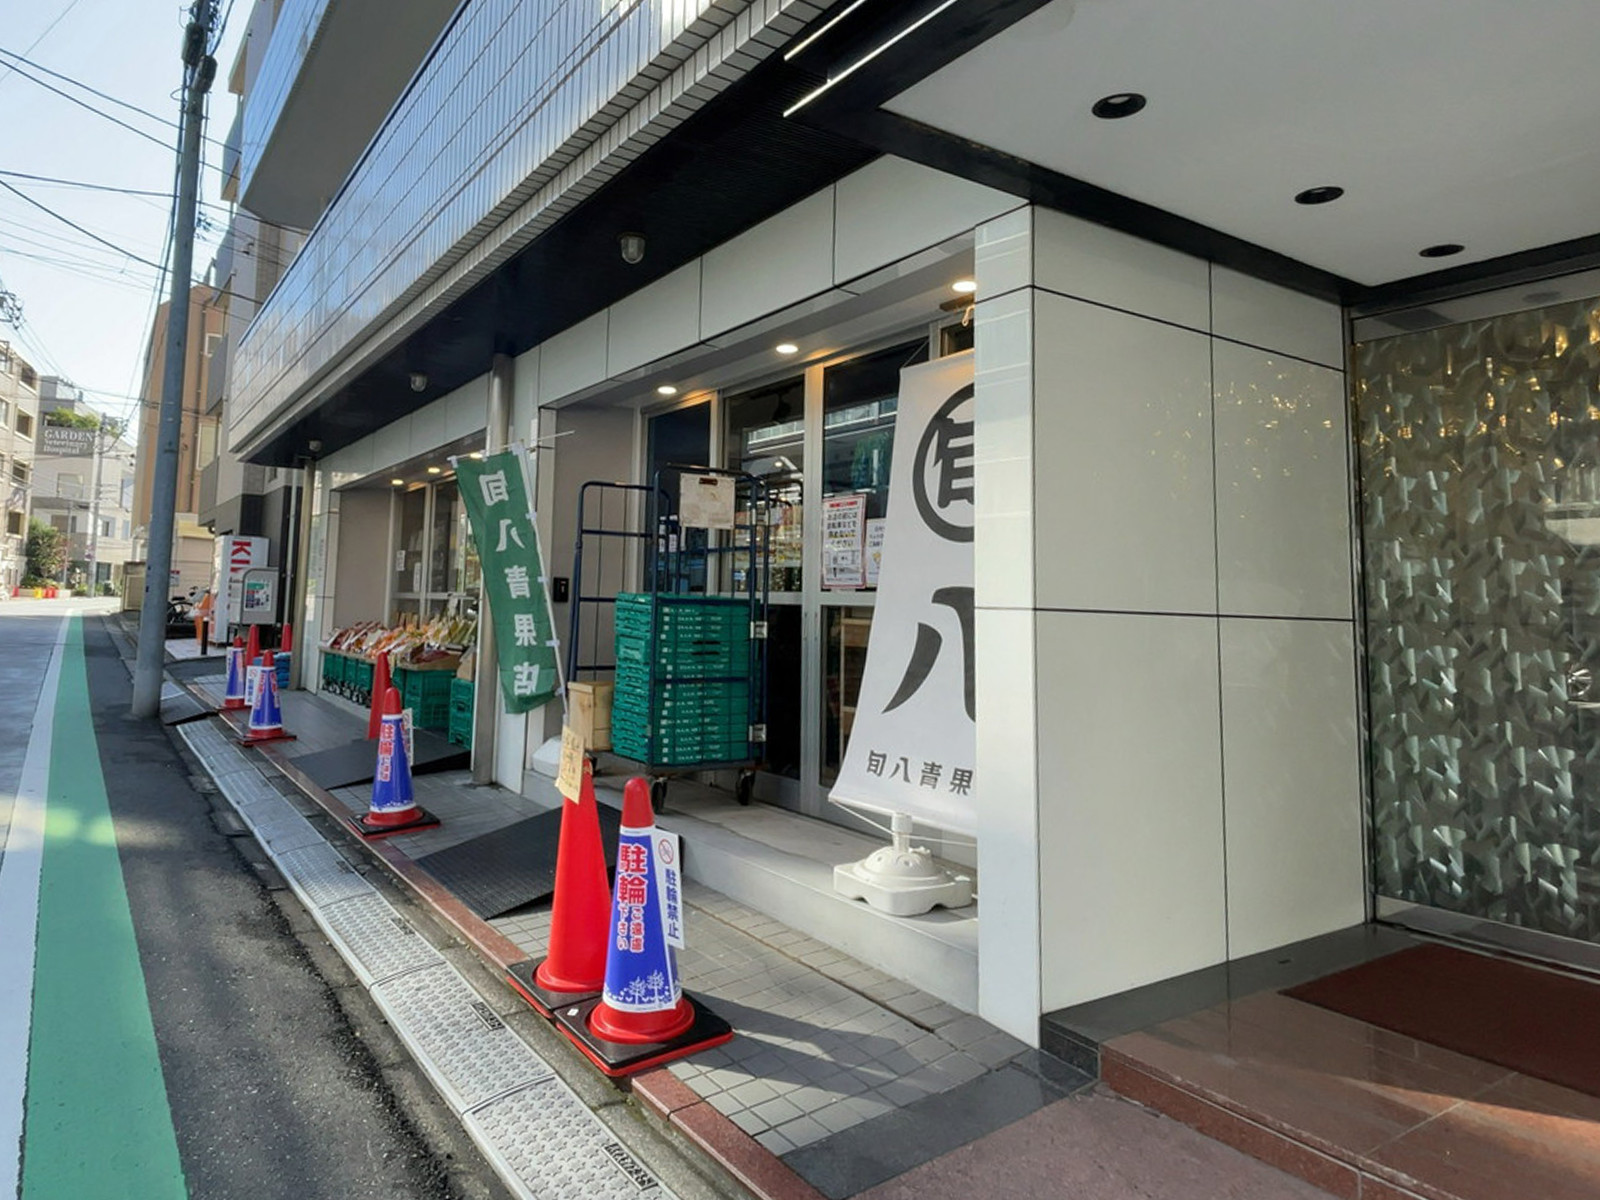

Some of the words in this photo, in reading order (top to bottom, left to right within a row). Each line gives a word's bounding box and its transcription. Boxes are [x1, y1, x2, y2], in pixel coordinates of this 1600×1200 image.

[44, 429, 93, 442] GARDEN
[866, 750, 974, 796] 旬八青果
[618, 844, 648, 905] 駐輪
[665, 868, 680, 940] 駐輪禁止
